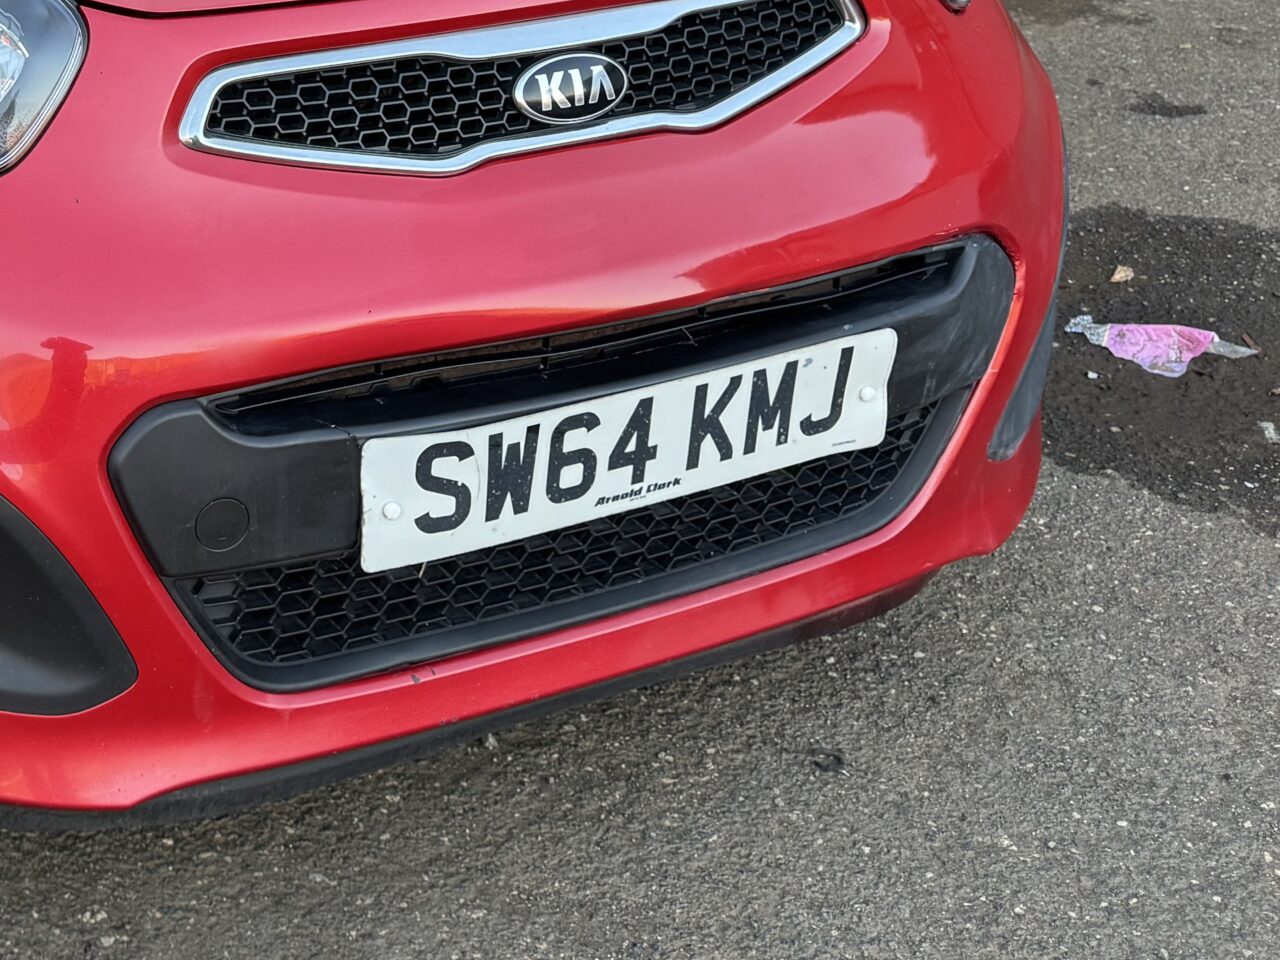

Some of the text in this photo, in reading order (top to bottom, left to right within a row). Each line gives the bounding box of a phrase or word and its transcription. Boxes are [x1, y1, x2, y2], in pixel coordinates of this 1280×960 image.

[534, 65, 616, 112] KIA
[414, 346, 855, 535] SW64 KMJ
[594, 477, 682, 507] Arnold Clark
